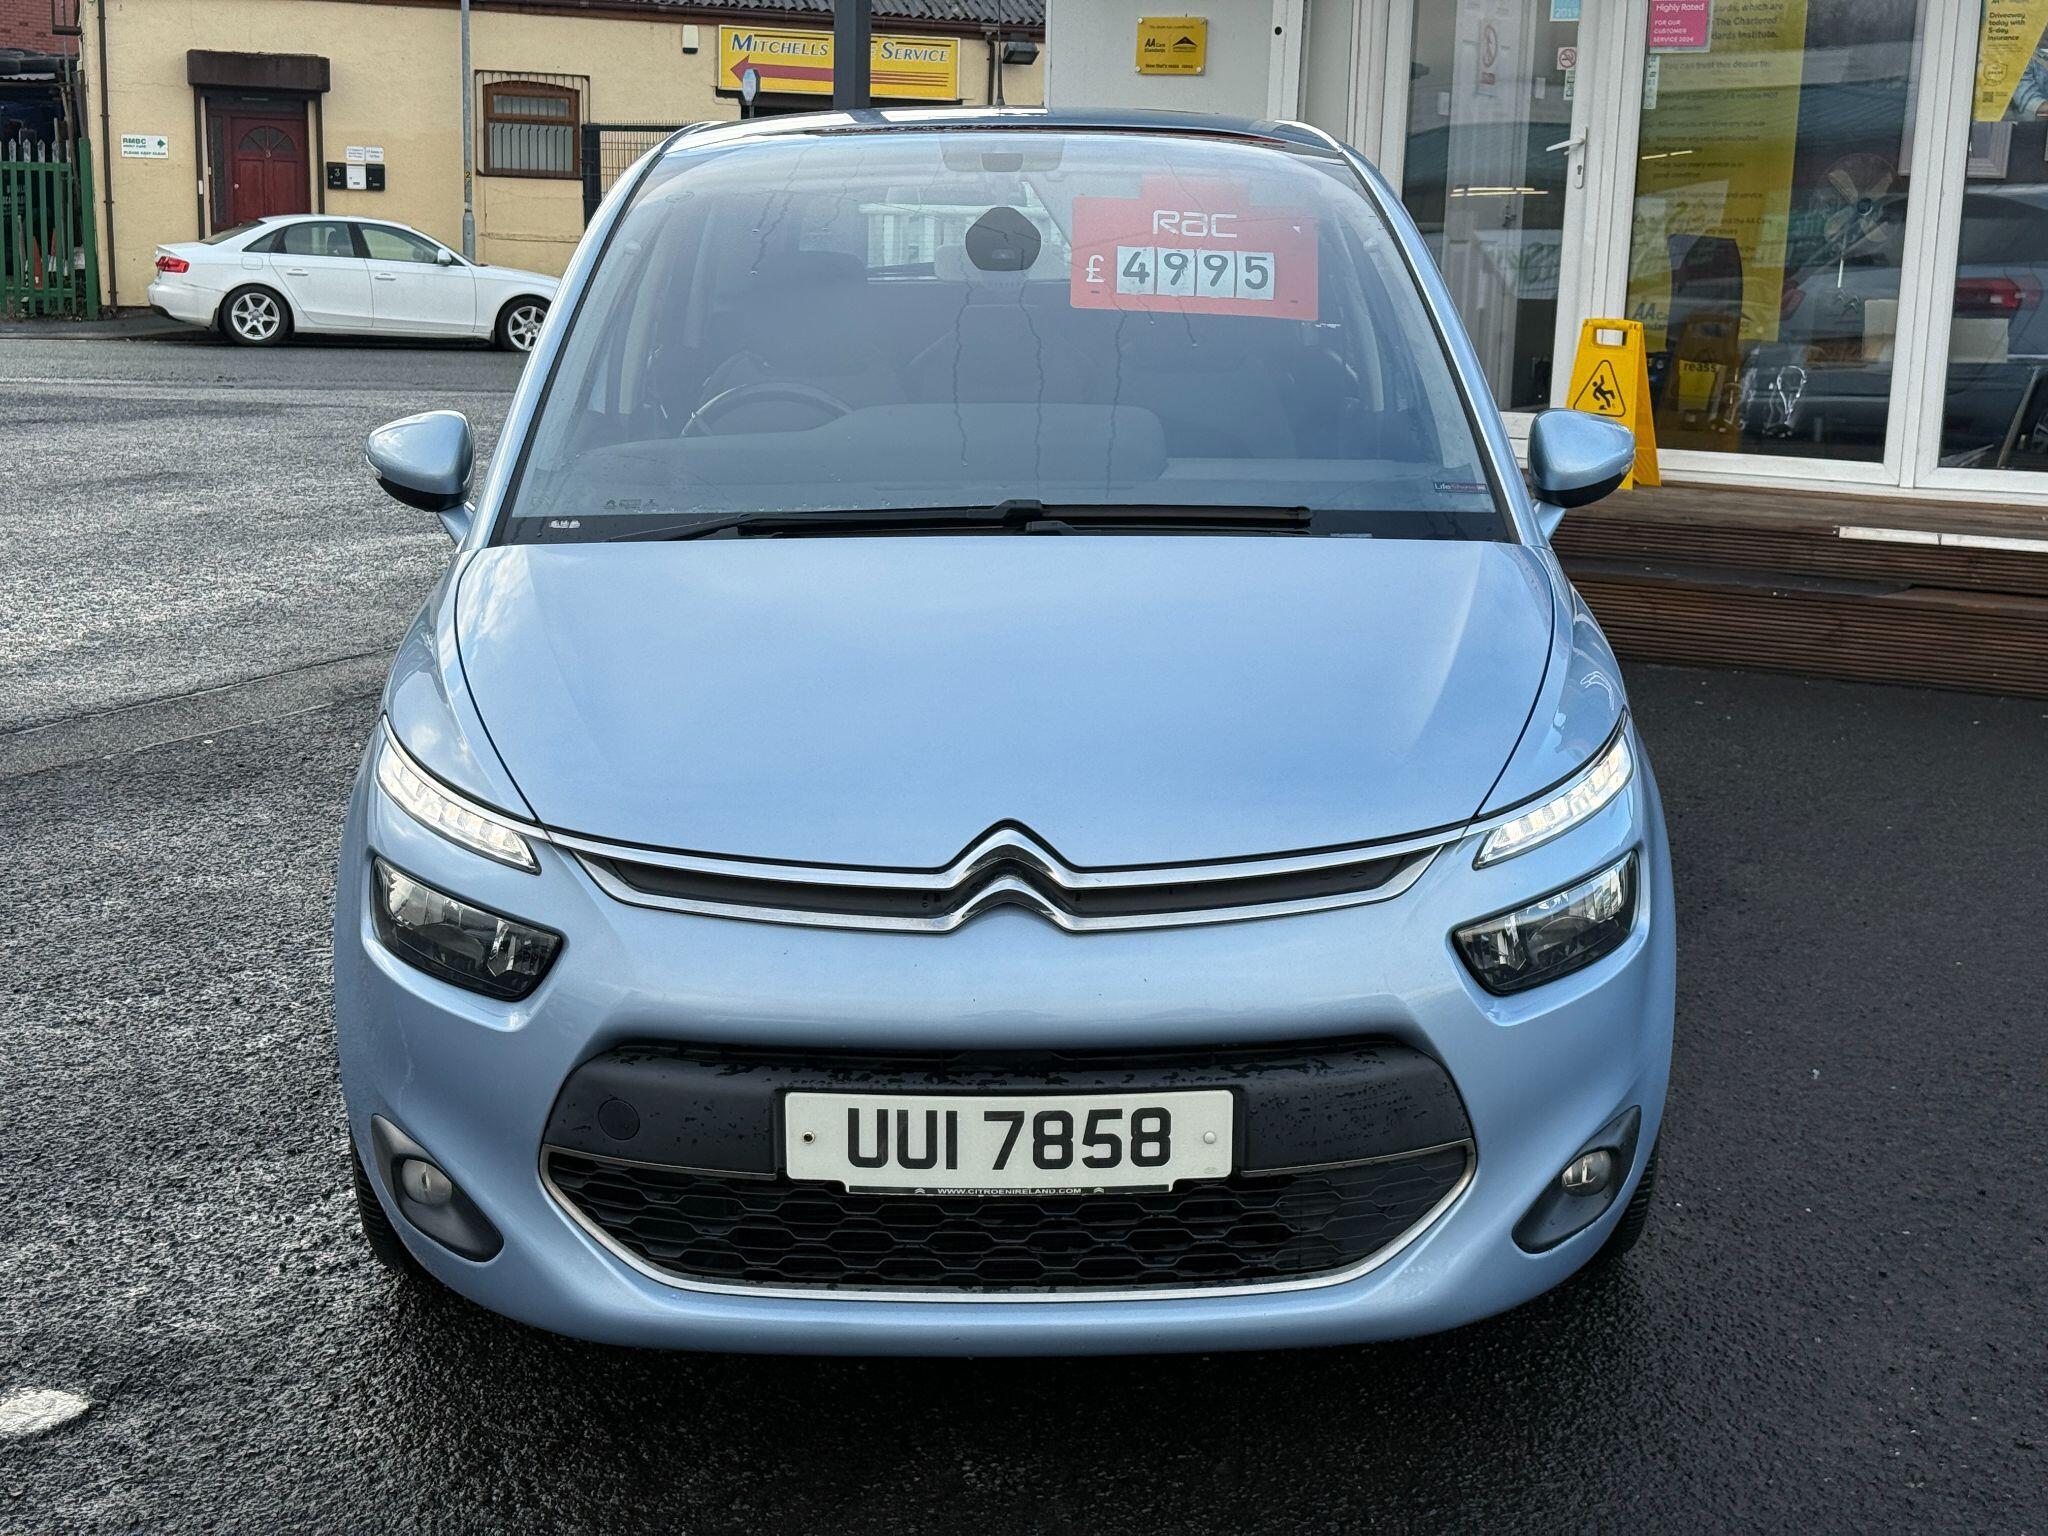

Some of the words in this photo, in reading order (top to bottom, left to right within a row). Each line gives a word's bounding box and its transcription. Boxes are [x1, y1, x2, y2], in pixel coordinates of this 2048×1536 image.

[1656, 3, 1679, 12] Highly
[1681, 3, 1704, 11] Rated
[1733, 16, 1777, 25] Chartered
[1145, 38, 1156, 47] AA
[731, 34, 829, 56] MITCHELLS
[881, 42, 949, 62] SERVICE
[1085, 254, 1105, 283] £
[1122, 250, 1270, 290] 4995
[983, 1106, 1172, 1171] 7858
[937, 1187, 1082, 1195] WWW.CITROENIRELAND.COM
